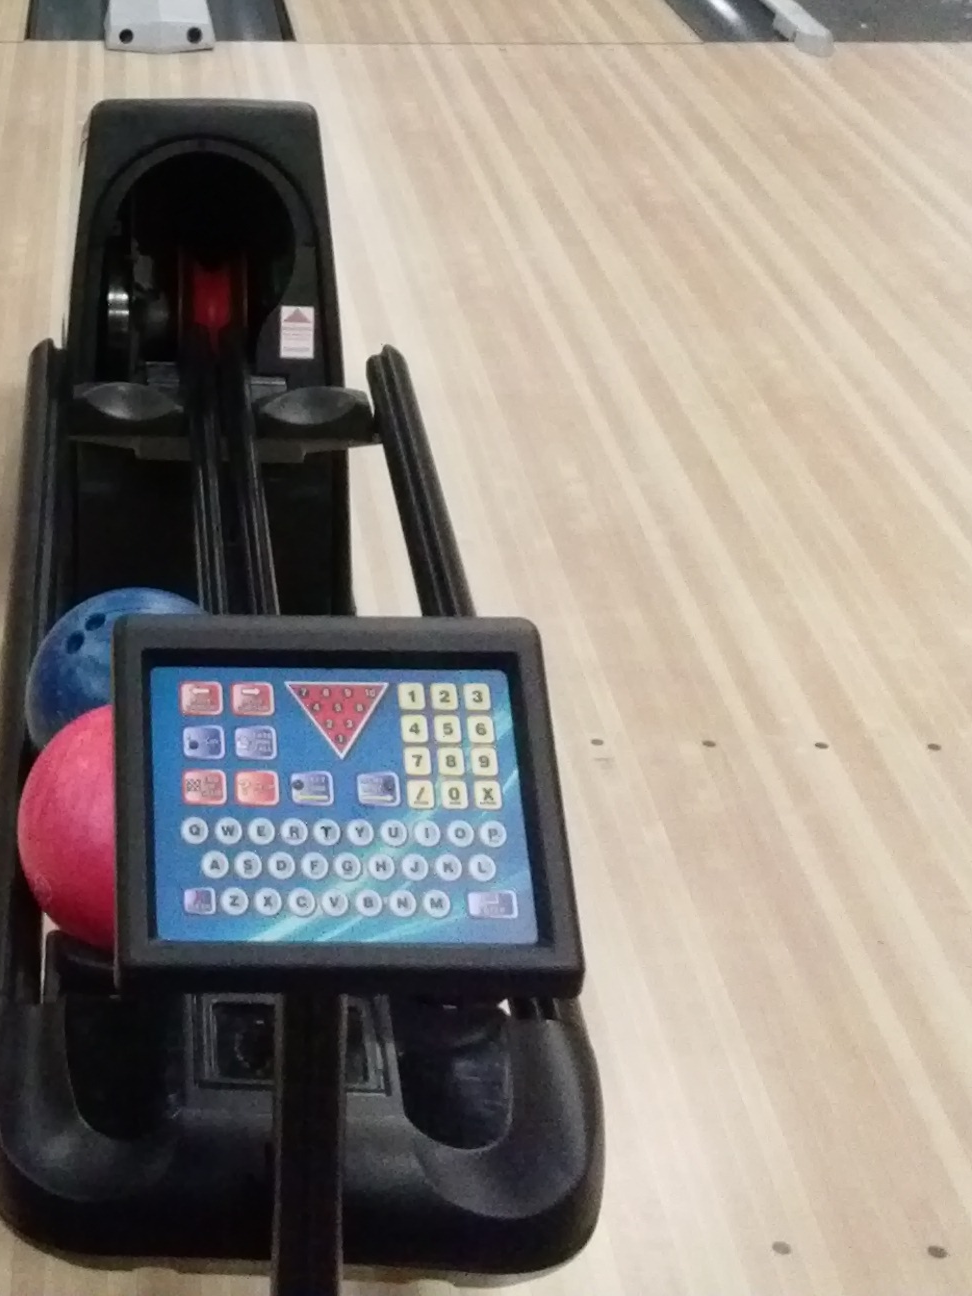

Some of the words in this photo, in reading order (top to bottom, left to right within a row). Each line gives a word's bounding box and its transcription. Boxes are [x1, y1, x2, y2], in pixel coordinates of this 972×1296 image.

[408, 691, 416, 703] 1
[439, 691, 450, 703] 2
[472, 691, 483, 703] 3
[409, 723, 420, 735] 4
[442, 723, 453, 735] 5
[475, 723, 487, 735] 6
[411, 755, 422, 767] 7
[445, 755, 456, 767] 8
[478, 755, 490, 767] 9
[482, 787, 494, 801] X
[188, 824, 200, 836] Q
[221, 825, 235, 836] W
[256, 826, 266, 837] E
[289, 826, 299, 837] R
[320, 826, 332, 837] T
[355, 827, 365, 838] Y
[388, 827, 398, 838] U
[424, 828, 429, 839] I
[454, 828, 466, 839] O
[488, 828, 498, 839] P
[210, 859, 220, 870] A
[243, 859, 252, 870] S
[276, 860, 286, 871] D
[310, 860, 319, 871] F
[341, 861, 353, 872] G
[375, 861, 386, 872] H
[410, 861, 419, 872] J
[443, 862, 453, 873] K
[477, 862, 486, 873] L
[229, 895, 239, 906] Z
[263, 896, 272, 907] X
[296, 896, 307, 907] C
[329, 896, 339, 907] V
[363, 897, 373, 908] B
[397, 897, 407, 908] N
[430, 897, 443, 909] M
